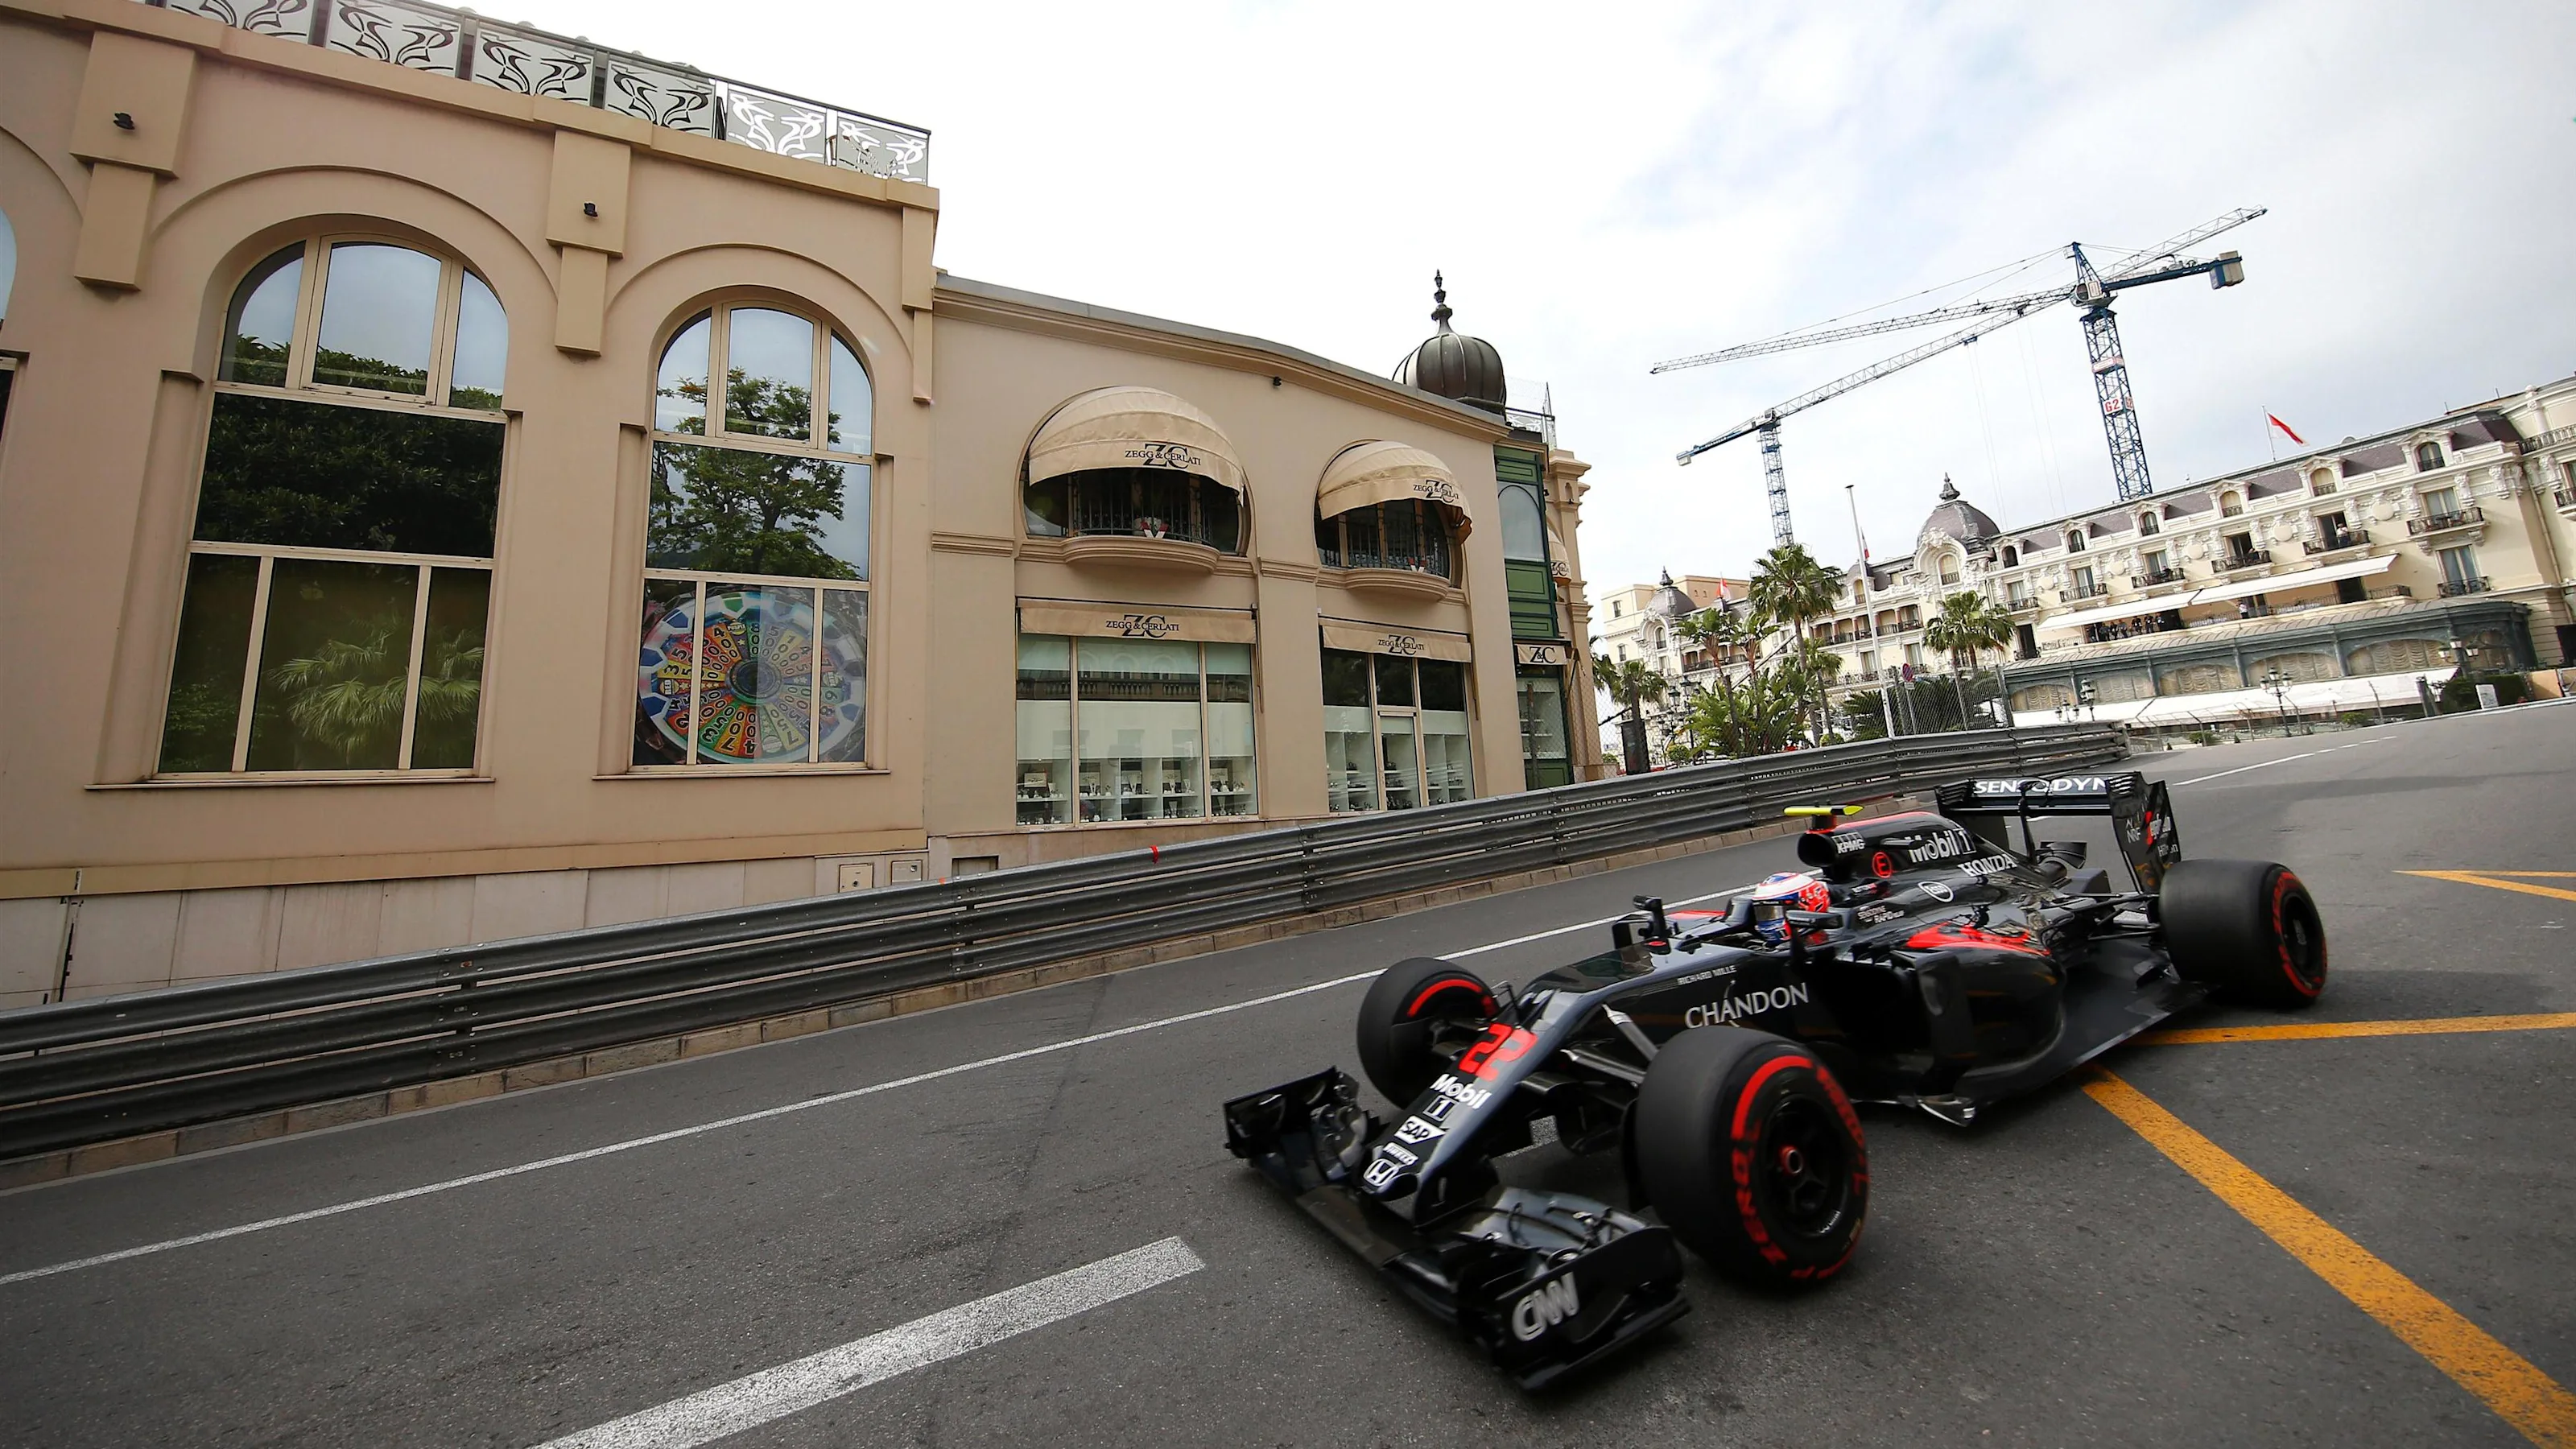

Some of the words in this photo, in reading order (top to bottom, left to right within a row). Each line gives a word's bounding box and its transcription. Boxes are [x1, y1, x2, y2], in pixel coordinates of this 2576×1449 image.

[2105, 398, 2120, 412] G2
[1125, 450, 1154, 459] ZEGG
[1164, 452, 1201, 466] CERLATI
[1105, 621, 1132, 629] ZEGG
[1133, 621, 1141, 630] &
[1141, 622, 1179, 631] CERLATI
[1530, 646, 1557, 664] Z&C
[1836, 839, 1865, 854] KPMG
[1905, 830, 1960, 863] Mobil
[1958, 853, 2018, 877] HONDA
[1685, 982, 1810, 1029] CHANDON
[1458, 1022, 1538, 1082] 22
[1430, 1073, 1492, 1110] Mobil
[1433, 1098, 1451, 1117] 1
[1402, 1120, 1430, 1140] SAP
[1512, 1271, 1580, 1342] CNN
